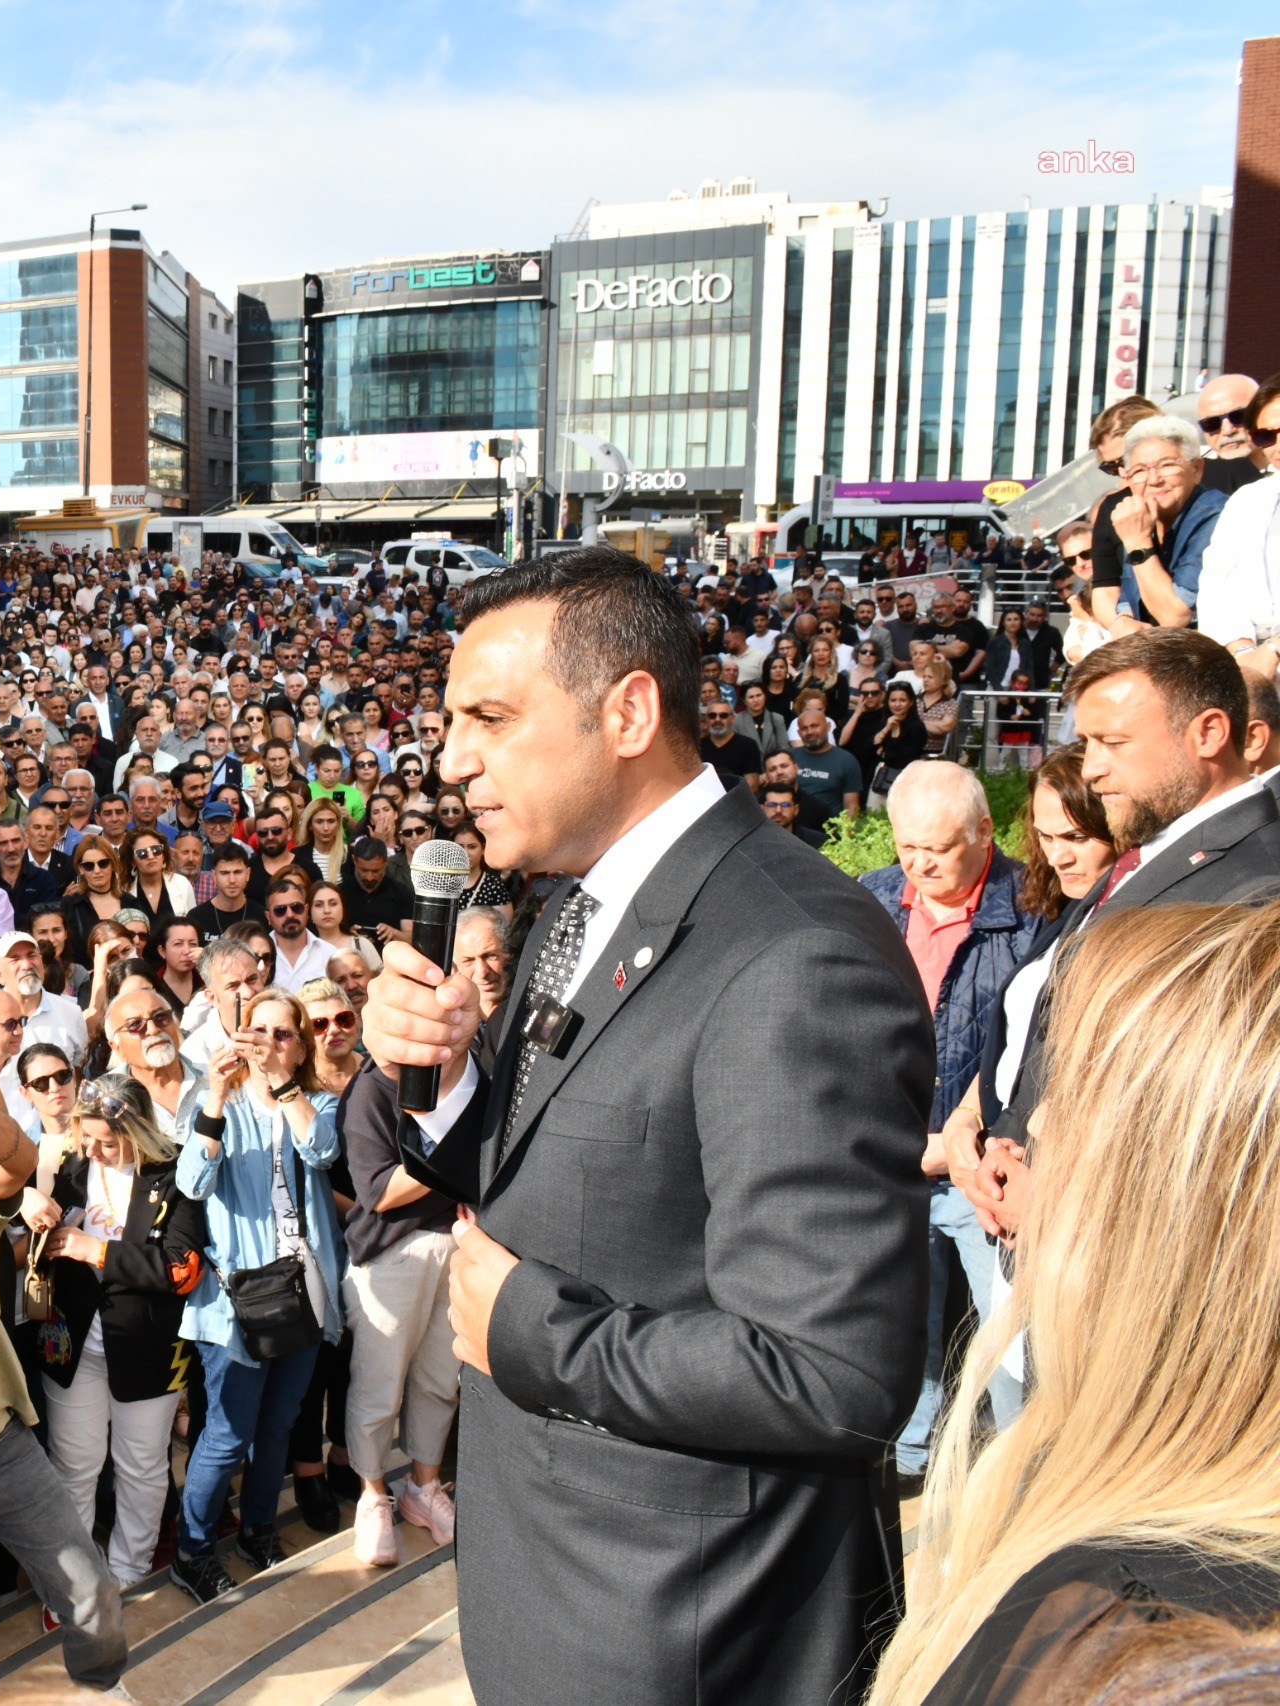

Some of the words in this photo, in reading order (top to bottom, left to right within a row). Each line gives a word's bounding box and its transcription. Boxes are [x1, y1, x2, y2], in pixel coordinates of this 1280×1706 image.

[576, 269, 733, 313] DeFacto
[1114, 264, 1141, 404] LALOĞ
[111, 494, 146, 506] EVKUR
[988, 485, 1021, 497] gratis
